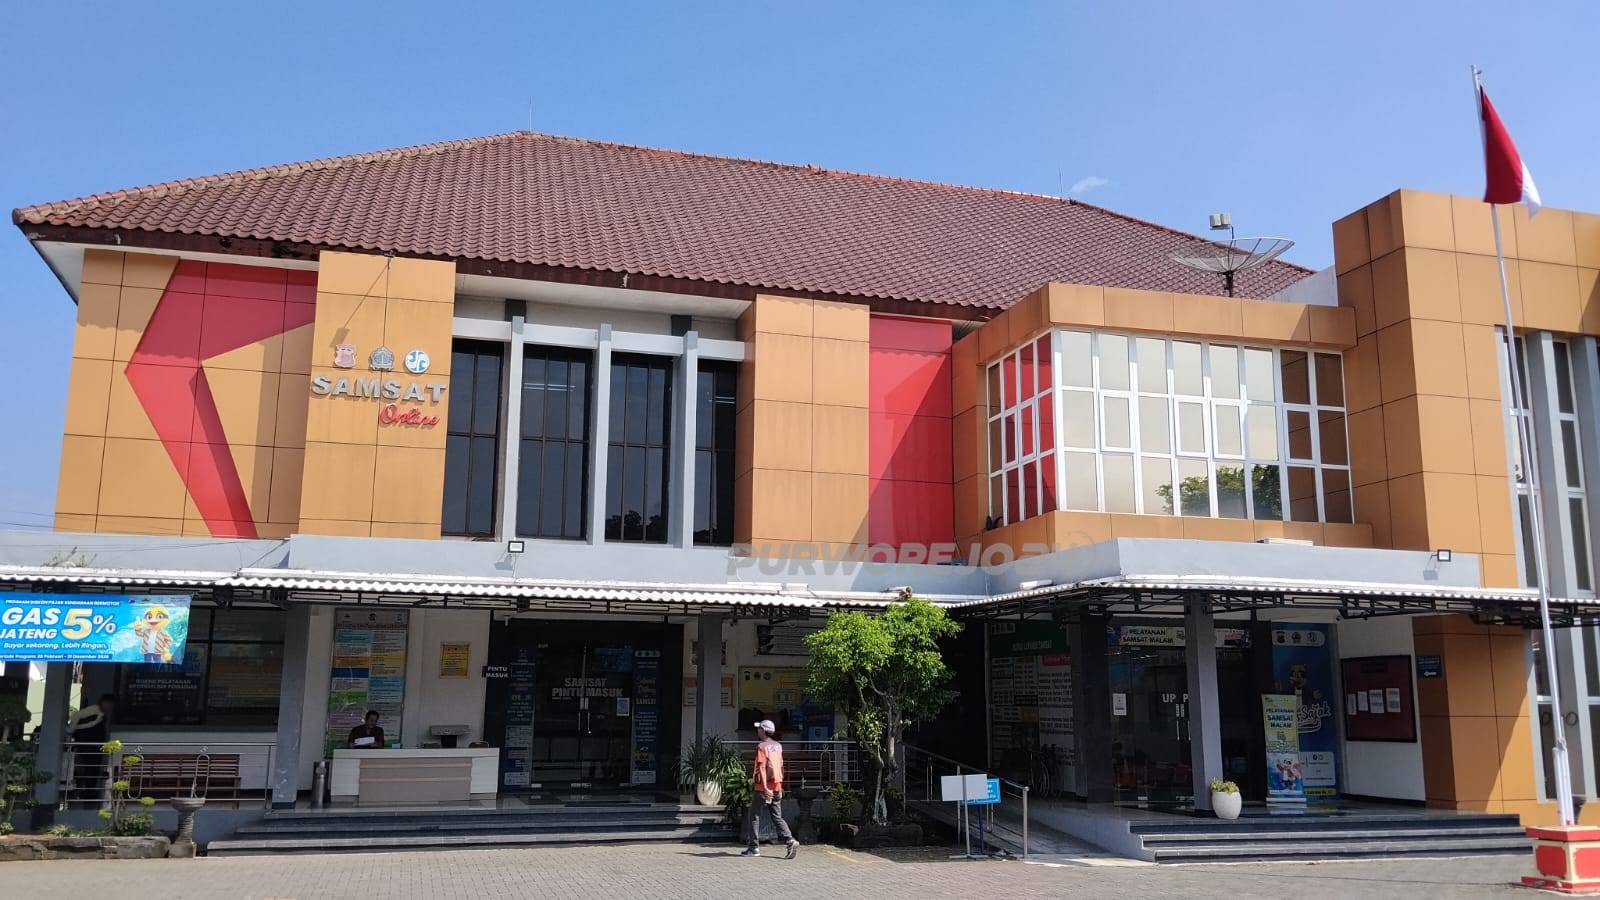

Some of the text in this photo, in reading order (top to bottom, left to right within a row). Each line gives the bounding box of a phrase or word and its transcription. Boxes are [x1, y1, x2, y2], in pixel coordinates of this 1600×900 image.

[311, 376, 448, 403] SAMSAT
[380, 402, 440, 426] Online
[2, 607, 117, 640] GAS 5%
[0, 628, 58, 639] JATENG
[4, 642, 25, 650] Bayar
[564, 677, 608, 687] SAMSAT
[551, 687, 624, 697] PINTU MASUK
